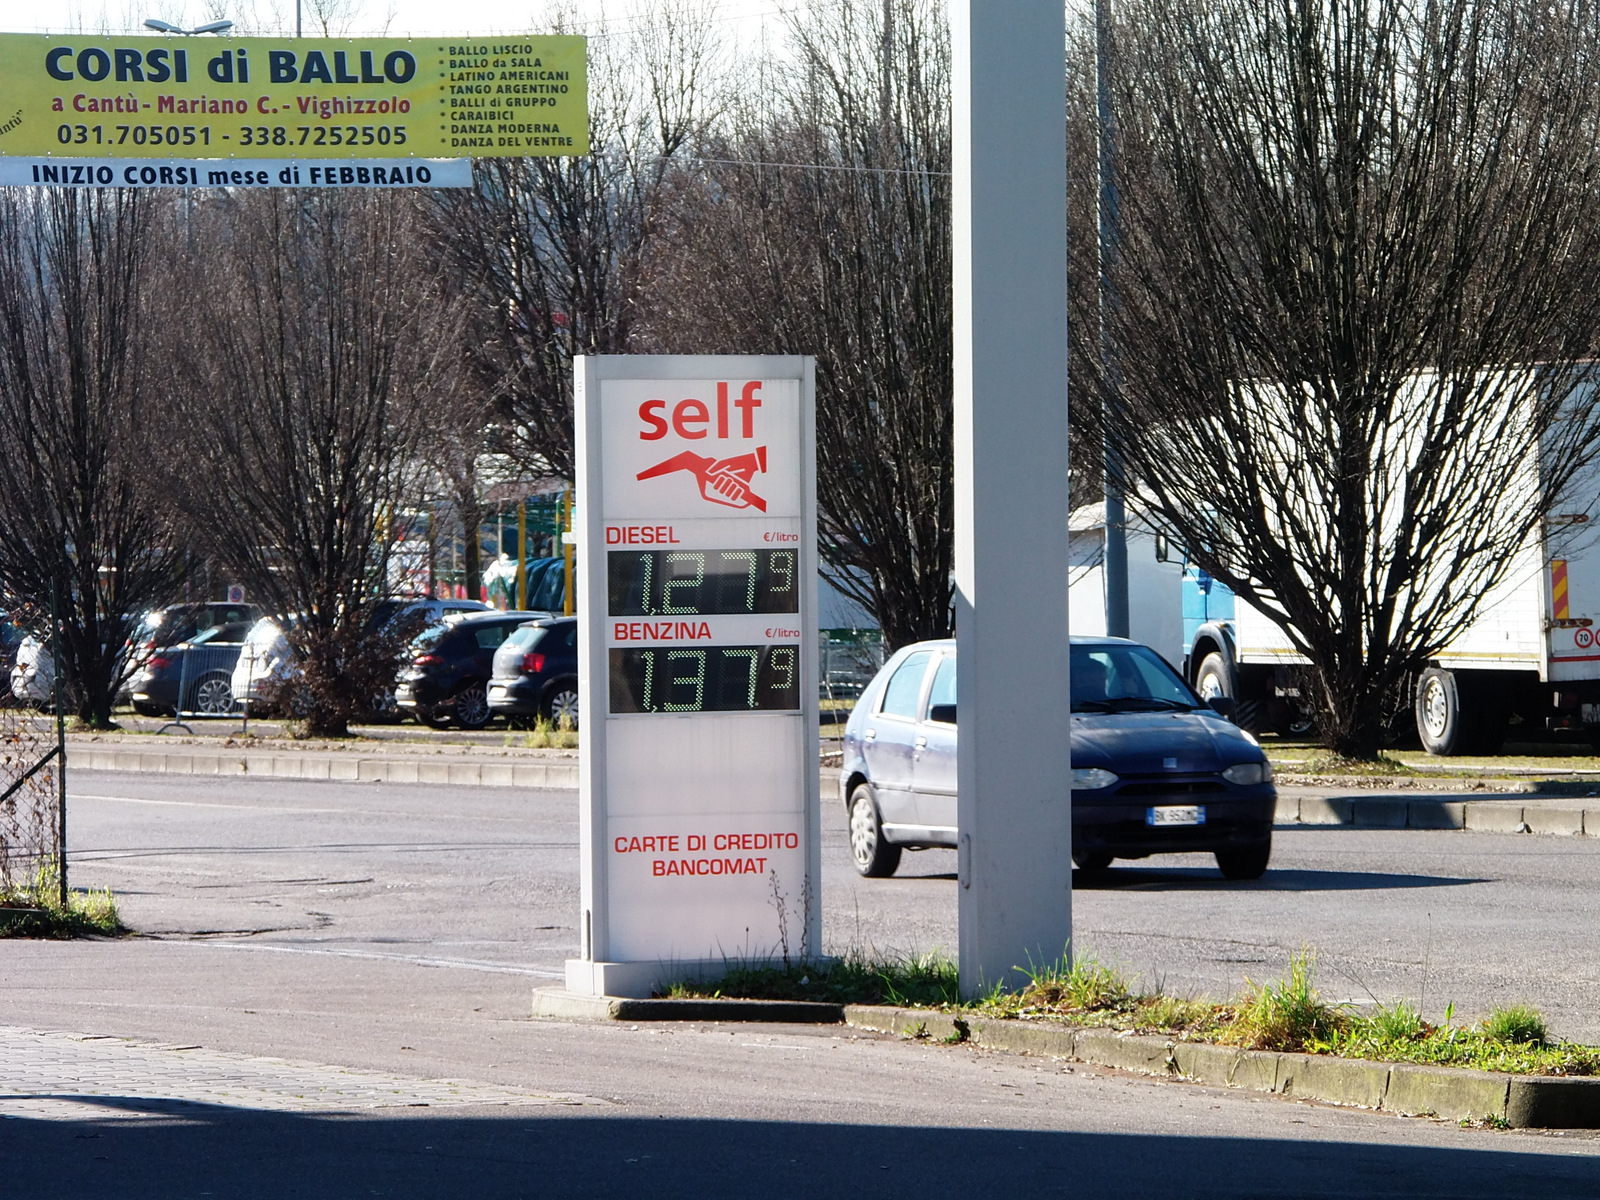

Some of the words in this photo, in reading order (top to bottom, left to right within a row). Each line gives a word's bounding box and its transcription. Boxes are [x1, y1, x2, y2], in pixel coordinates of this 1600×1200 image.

[449, 46, 488, 55] BALLO
[493, 45, 532, 54] LISCIO
[45, 47, 187, 82] CORSI
[207, 48, 249, 83] di
[269, 50, 415, 84] BALLO
[449, 59, 488, 68] BALLO
[511, 58, 541, 67] SALA
[450, 72, 495, 82] LATINO
[500, 71, 569, 81] AMERICANI
[450, 85, 491, 94] TANGO
[496, 84, 568, 94] ARGENTINO
[52, 97, 63, 111] a
[157, 96, 248, 114] Mariano
[297, 96, 411, 119] Vighizzolo
[450, 98, 485, 107] BALLI
[490, 98, 501, 107] di
[506, 97, 556, 106] GRUPPO
[450, 111, 514, 120] CARAIBICI
[57, 124, 211, 146] 031.705051
[239, 126, 407, 146] 338.7252505
[451, 125, 493, 134] DANZA
[498, 124, 560, 133] MODERNA
[451, 138, 493, 147] DANZA
[498, 137, 521, 146] DEL
[525, 137, 573, 146] VENTRE
[32, 165, 114, 184] INIZIO
[123, 166, 197, 185] CORSI
[208, 170, 269, 185] mese
[278, 166, 300, 185] di
[309, 166, 432, 185] FEBBRAIO
[637, 380, 763, 441] self
[605, 526, 681, 545] DIESEL
[613, 621, 712, 641] BENZINA
[1579, 633, 1589, 642] 70
[614, 835, 680, 853] CARTE
[687, 834, 707, 851] DI
[714, 832, 799, 851] CREDITO
[652, 857, 768, 877] BANCOMAT
